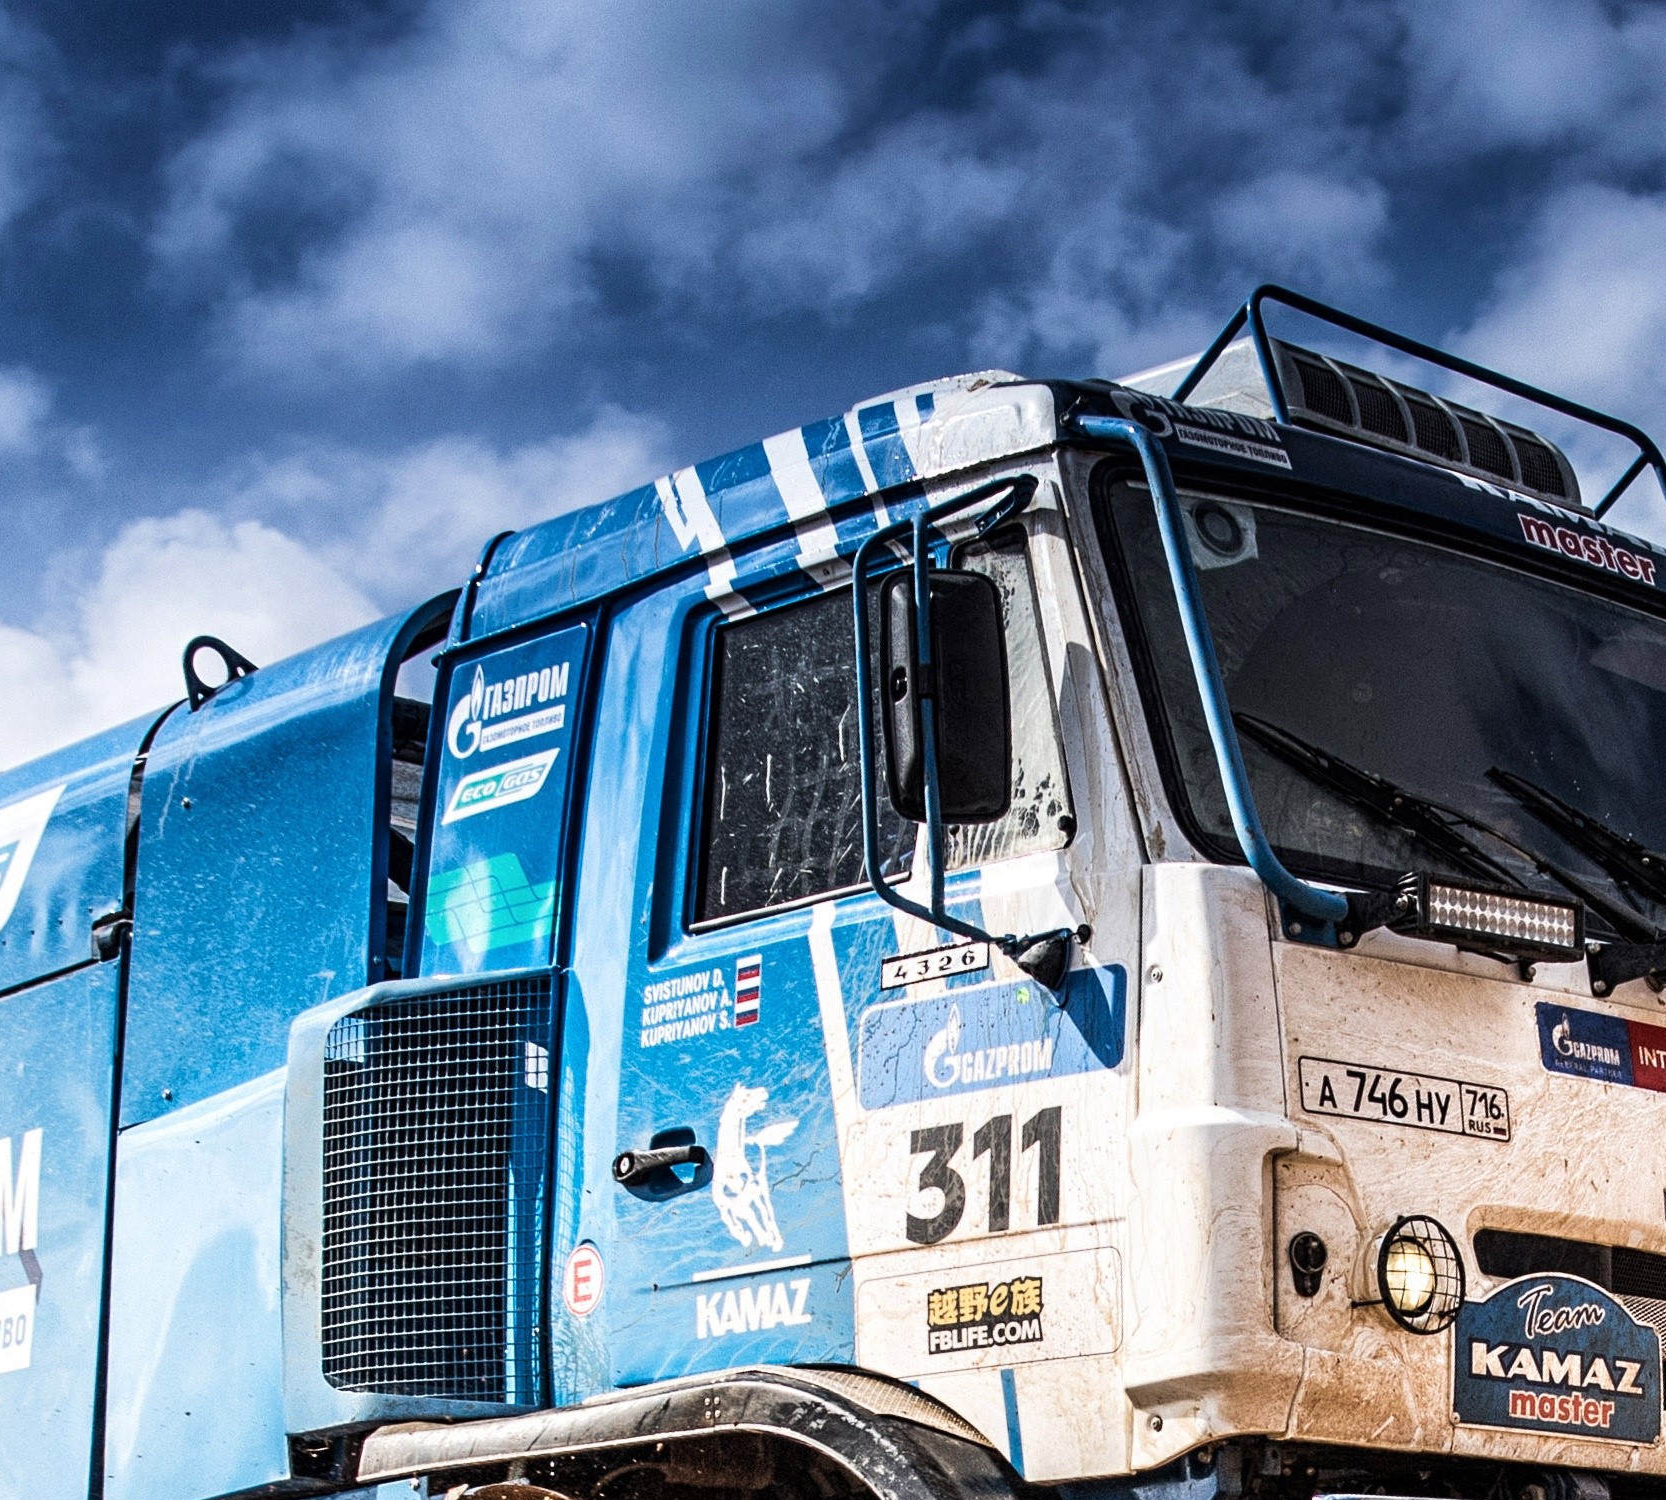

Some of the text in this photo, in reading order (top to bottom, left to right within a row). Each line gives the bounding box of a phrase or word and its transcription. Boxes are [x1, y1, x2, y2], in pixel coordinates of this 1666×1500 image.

[1517, 513, 1656, 586] master
[483, 661, 570, 721] ГАЗПРОМ
[642, 988, 733, 1027] KUPRIYANOV A.
[643, 968, 725, 1005] SVISTUNOV D.
[640, 1010, 732, 1049] KUPRIYANOV S.
[961, 1037, 1053, 1084] GAZPROM
[1573, 1041, 1621, 1066] GAZPROM
[1346, 1069, 1409, 1119] 746
[1465, 1089, 1502, 1120] 716
[1468, 1119, 1492, 1134] RUS
[905, 1106, 1064, 1246] 311
[571, 1259, 593, 1304] E
[694, 1278, 812, 1340] KAMAZ
[1517, 1284, 1606, 1340] Team
[929, 1318, 1041, 1352] FBLIFE.COM
[1470, 1341, 1644, 1395] KAMAZ
[1508, 1389, 1616, 1429] master
